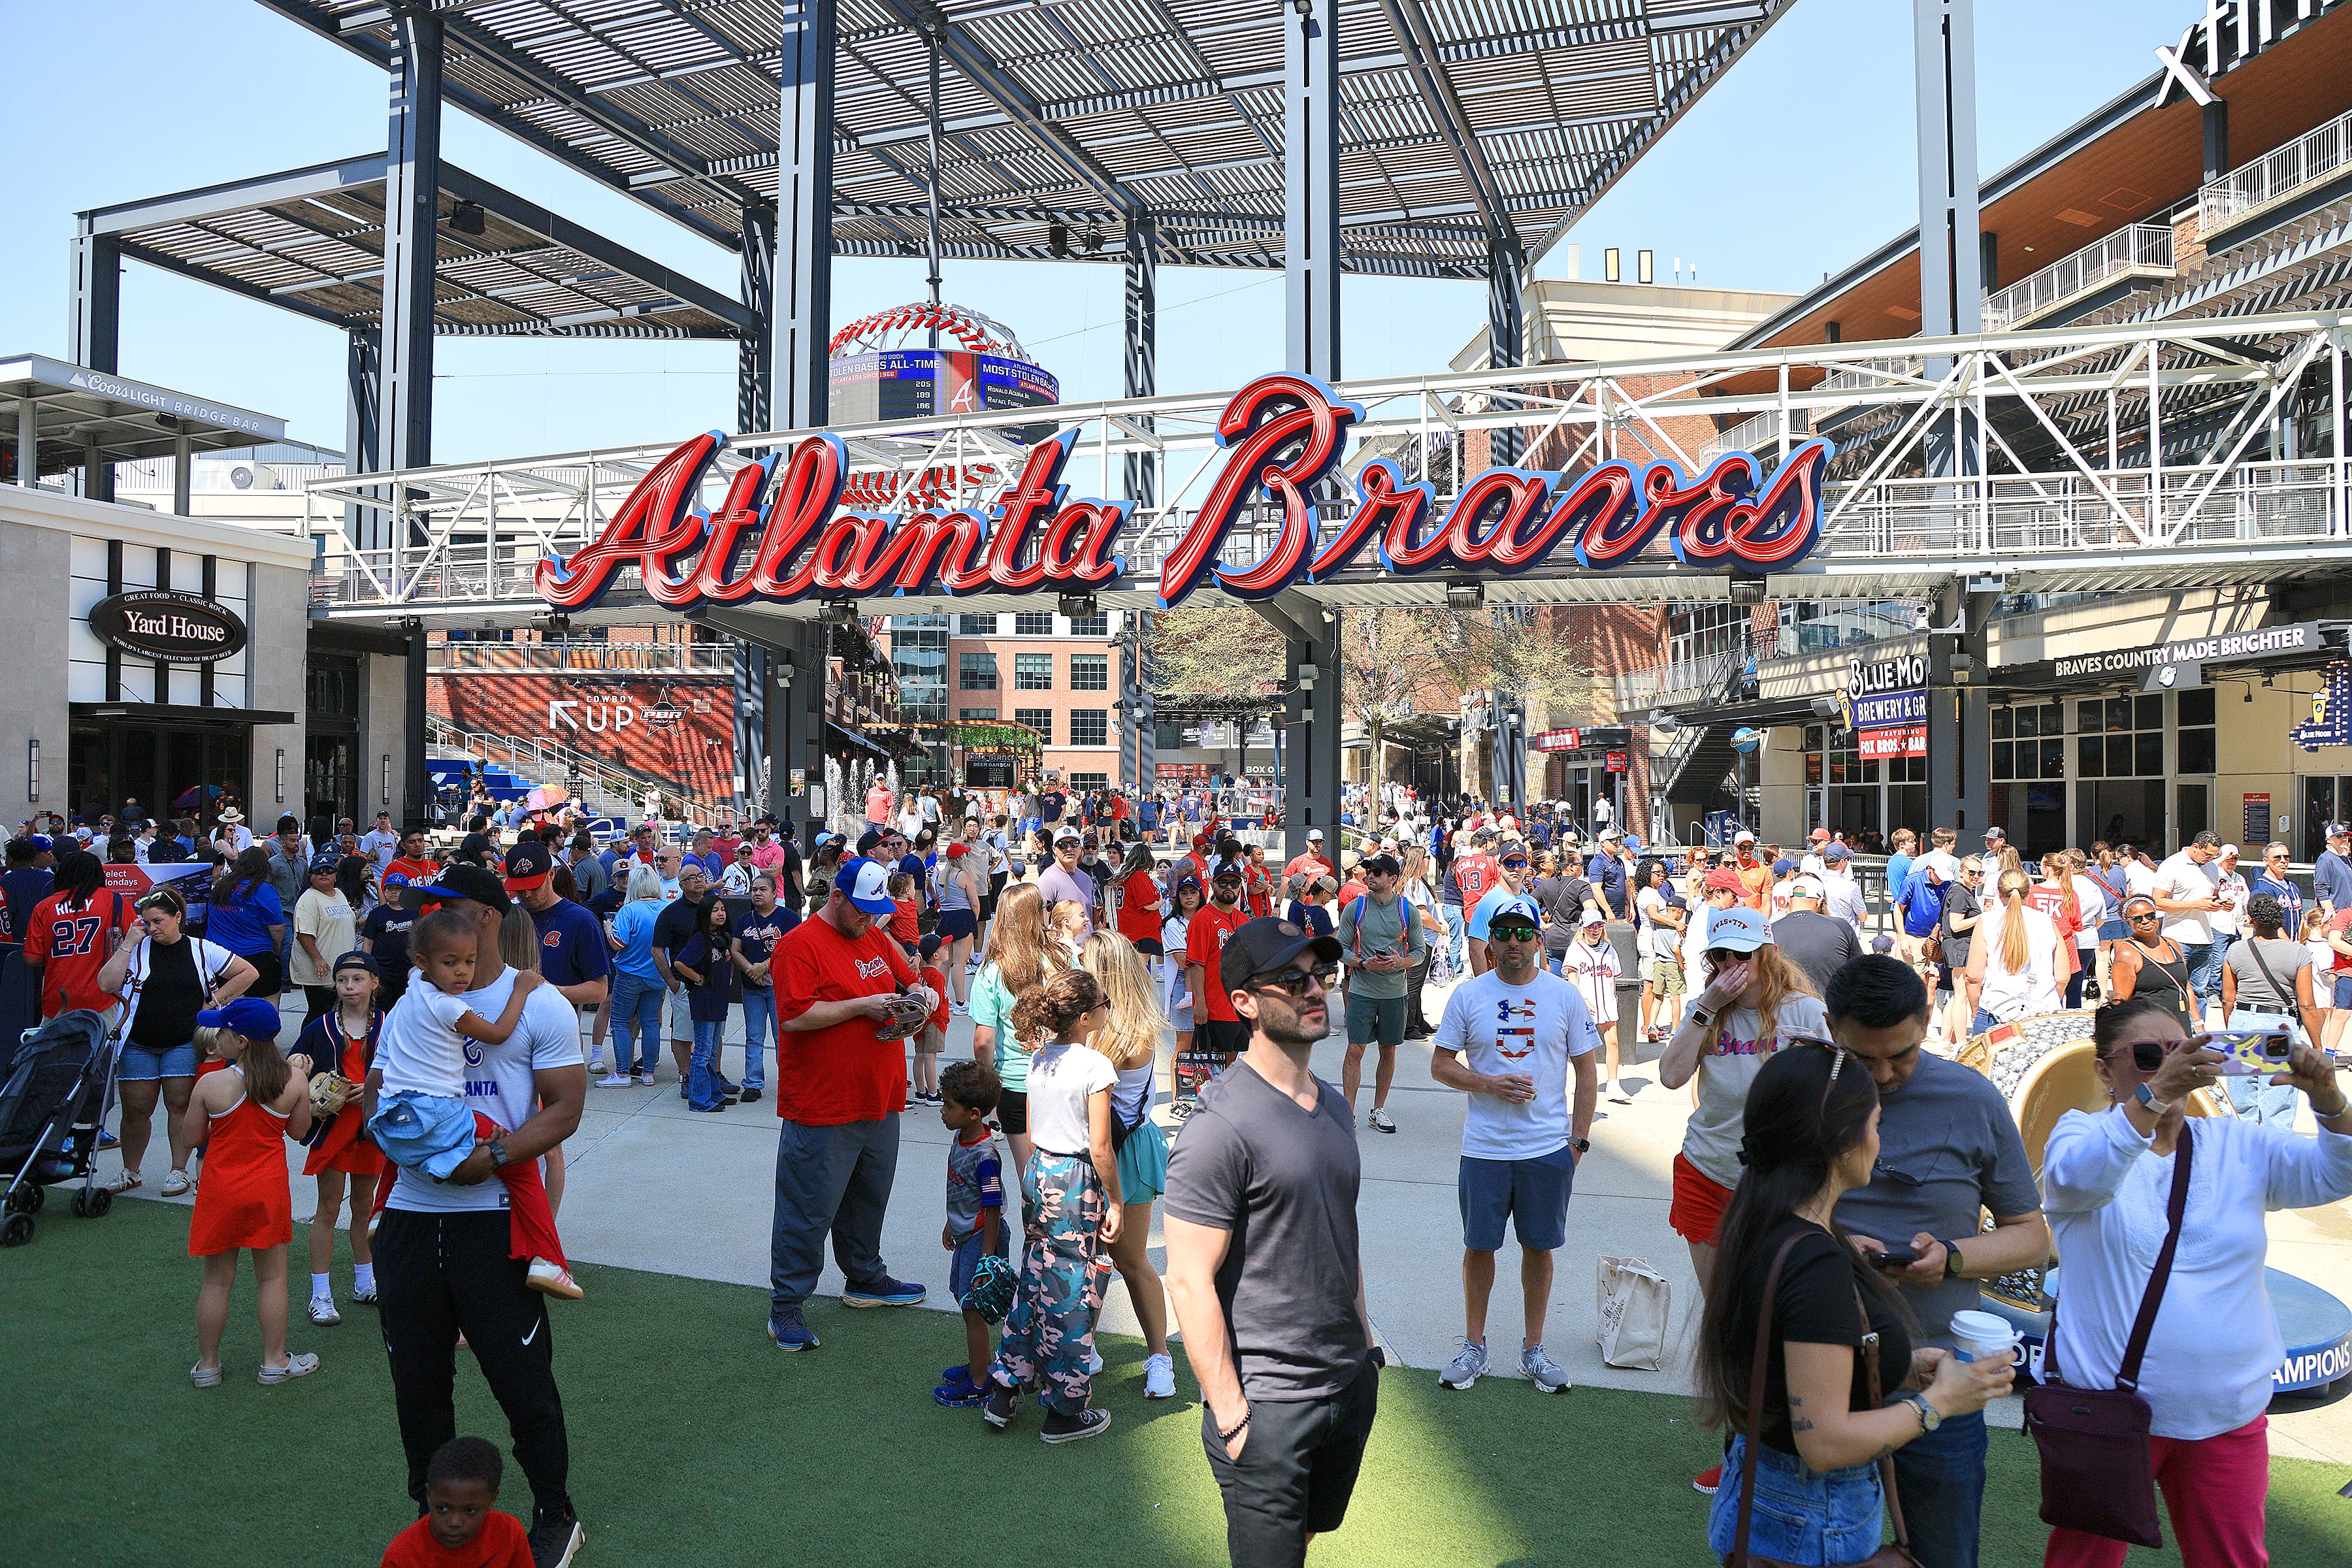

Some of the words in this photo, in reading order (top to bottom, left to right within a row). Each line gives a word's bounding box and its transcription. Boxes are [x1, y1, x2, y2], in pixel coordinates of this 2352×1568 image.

[830, 364, 853, 378] TOLEN
[855, 361, 887, 373] BASES
[890, 359, 940, 370] ALL-TIME
[865, 354, 887, 363] RECORD
[1013, 363, 1032, 373] ATLANTA
[832, 375, 852, 385] ATLANTA
[983, 363, 1010, 376] MOST
[1011, 368, 1039, 385] STOLEN
[87, 374, 129, 398] Coors
[130, 389, 166, 408] LIGHT
[987, 385, 1008, 395] RONALD
[1021, 382, 1039, 392] ATLANTA
[987, 396, 1007, 406] RAFAEL
[174, 400, 227, 425] BRIDGE
[232, 416, 259, 433] BAR
[1002, 431, 1022, 440] MURPHY
[536, 428, 1137, 613] Atlanta
[1156, 371, 1835, 610] Braves
[124, 593, 148, 602] GREAT
[179, 595, 207, 608] CLASSIC
[208, 602, 229, 616] ROCK
[124, 610, 167, 636] Yard
[170, 615, 225, 642] House
[112, 635, 137, 652] WORLD'S
[137, 647, 162, 659] LARGEST
[219, 649, 233, 659] BEER
[2055, 656, 2102, 677] BRAVES
[2106, 647, 2171, 671] COUNTRY
[2172, 640, 2218, 662] MADE
[2221, 627, 2306, 657] BRIGHTER
[1848, 658, 1894, 700] BLUE
[586, 706, 634, 732] UP
[1857, 698, 1903, 723] BREWERY
[1904, 696, 1912, 717] &
[1469, 731, 1482, 743] STORE
[1731, 737, 1746, 747] BLUE
[1746, 732, 1761, 742] MOON
[1880, 728, 1920, 737] FEATURING
[2300, 730, 2315, 740] BLUE
[1860, 740, 1875, 755] FOX
[1876, 737, 1901, 753] BROS.
[1665, 754, 1690, 792] BRIGHTER
[1689, 732, 1705, 757] TIMES
[1188, 801, 1195, 809] 5
[1463, 871, 1482, 892] 13
[2036, 898, 2064, 918] 5K
[52, 917, 101, 958] 27
[465, 1081, 498, 1096] ANTA
[2270, 1341, 2351, 1385] AMPIONS
